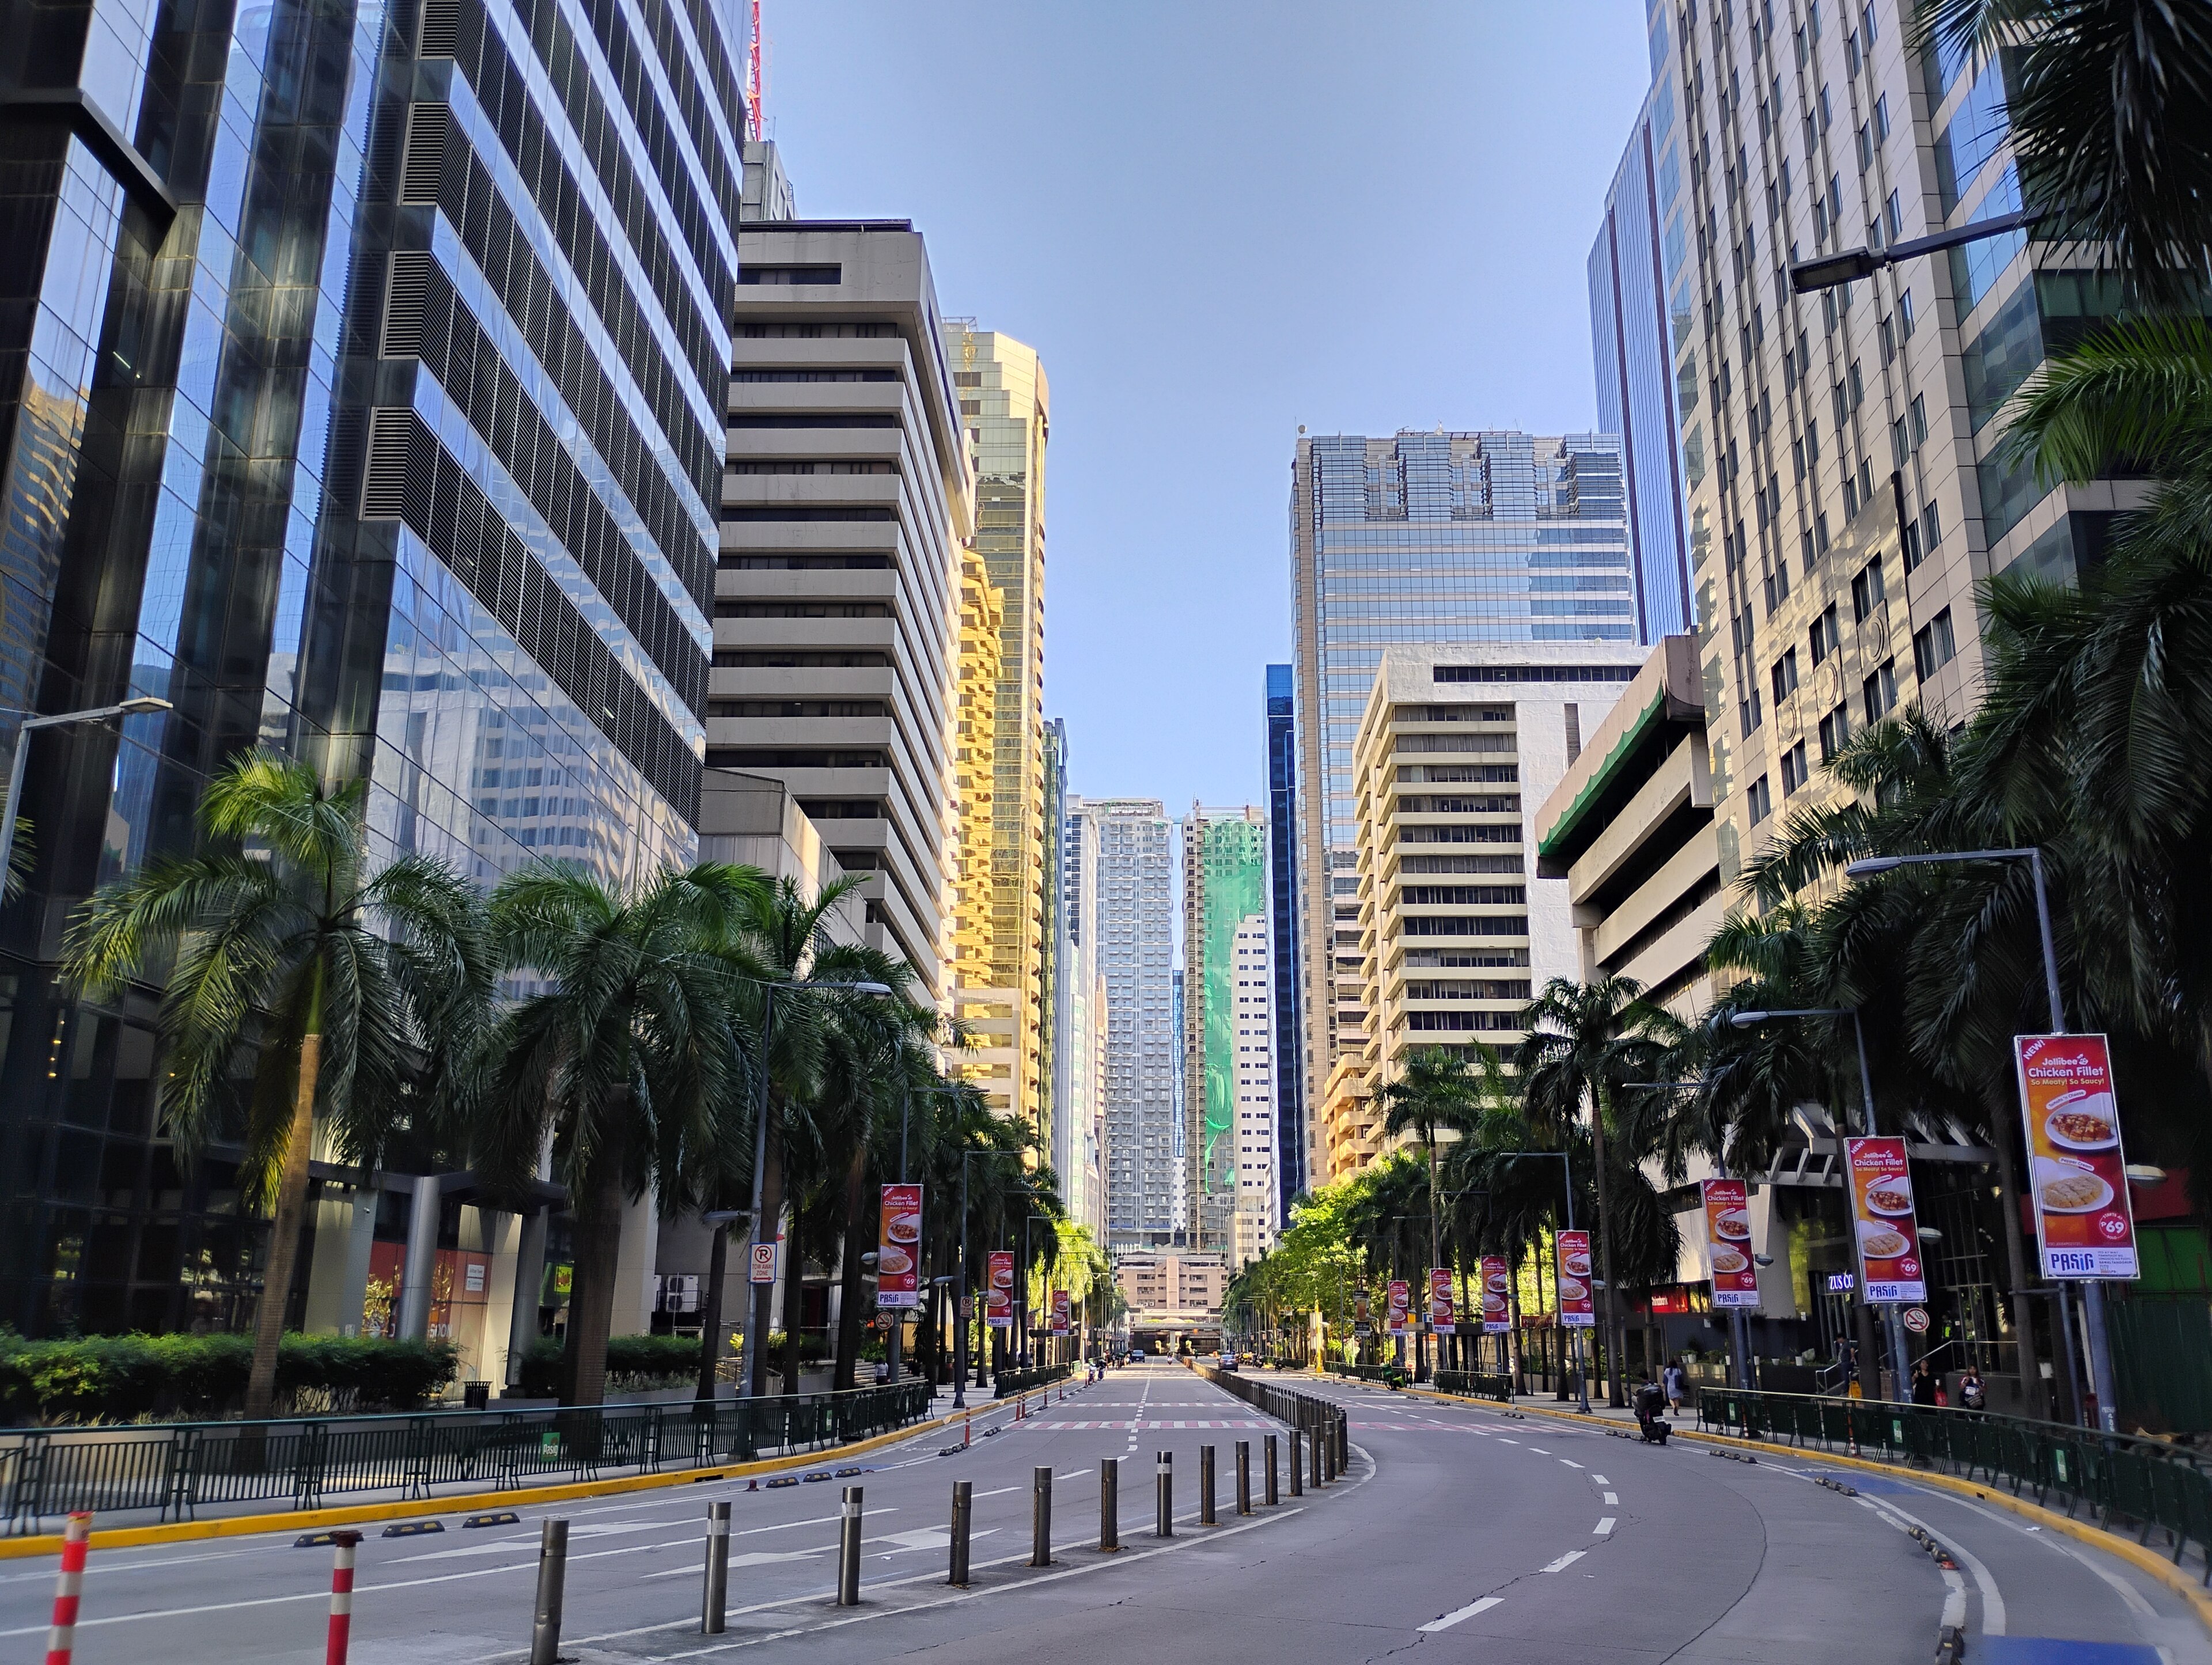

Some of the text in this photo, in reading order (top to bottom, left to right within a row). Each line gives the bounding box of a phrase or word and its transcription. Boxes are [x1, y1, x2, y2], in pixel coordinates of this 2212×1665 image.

[2023, 1040, 2045, 1060] NEW!
[2042, 1057, 2077, 1065] Jollibee
[2028, 1067, 2104, 1077] Chicken Fillet
[1851, 1140, 1865, 1154] NEW!
[1828, 1275, 1843, 1289] ZUS
